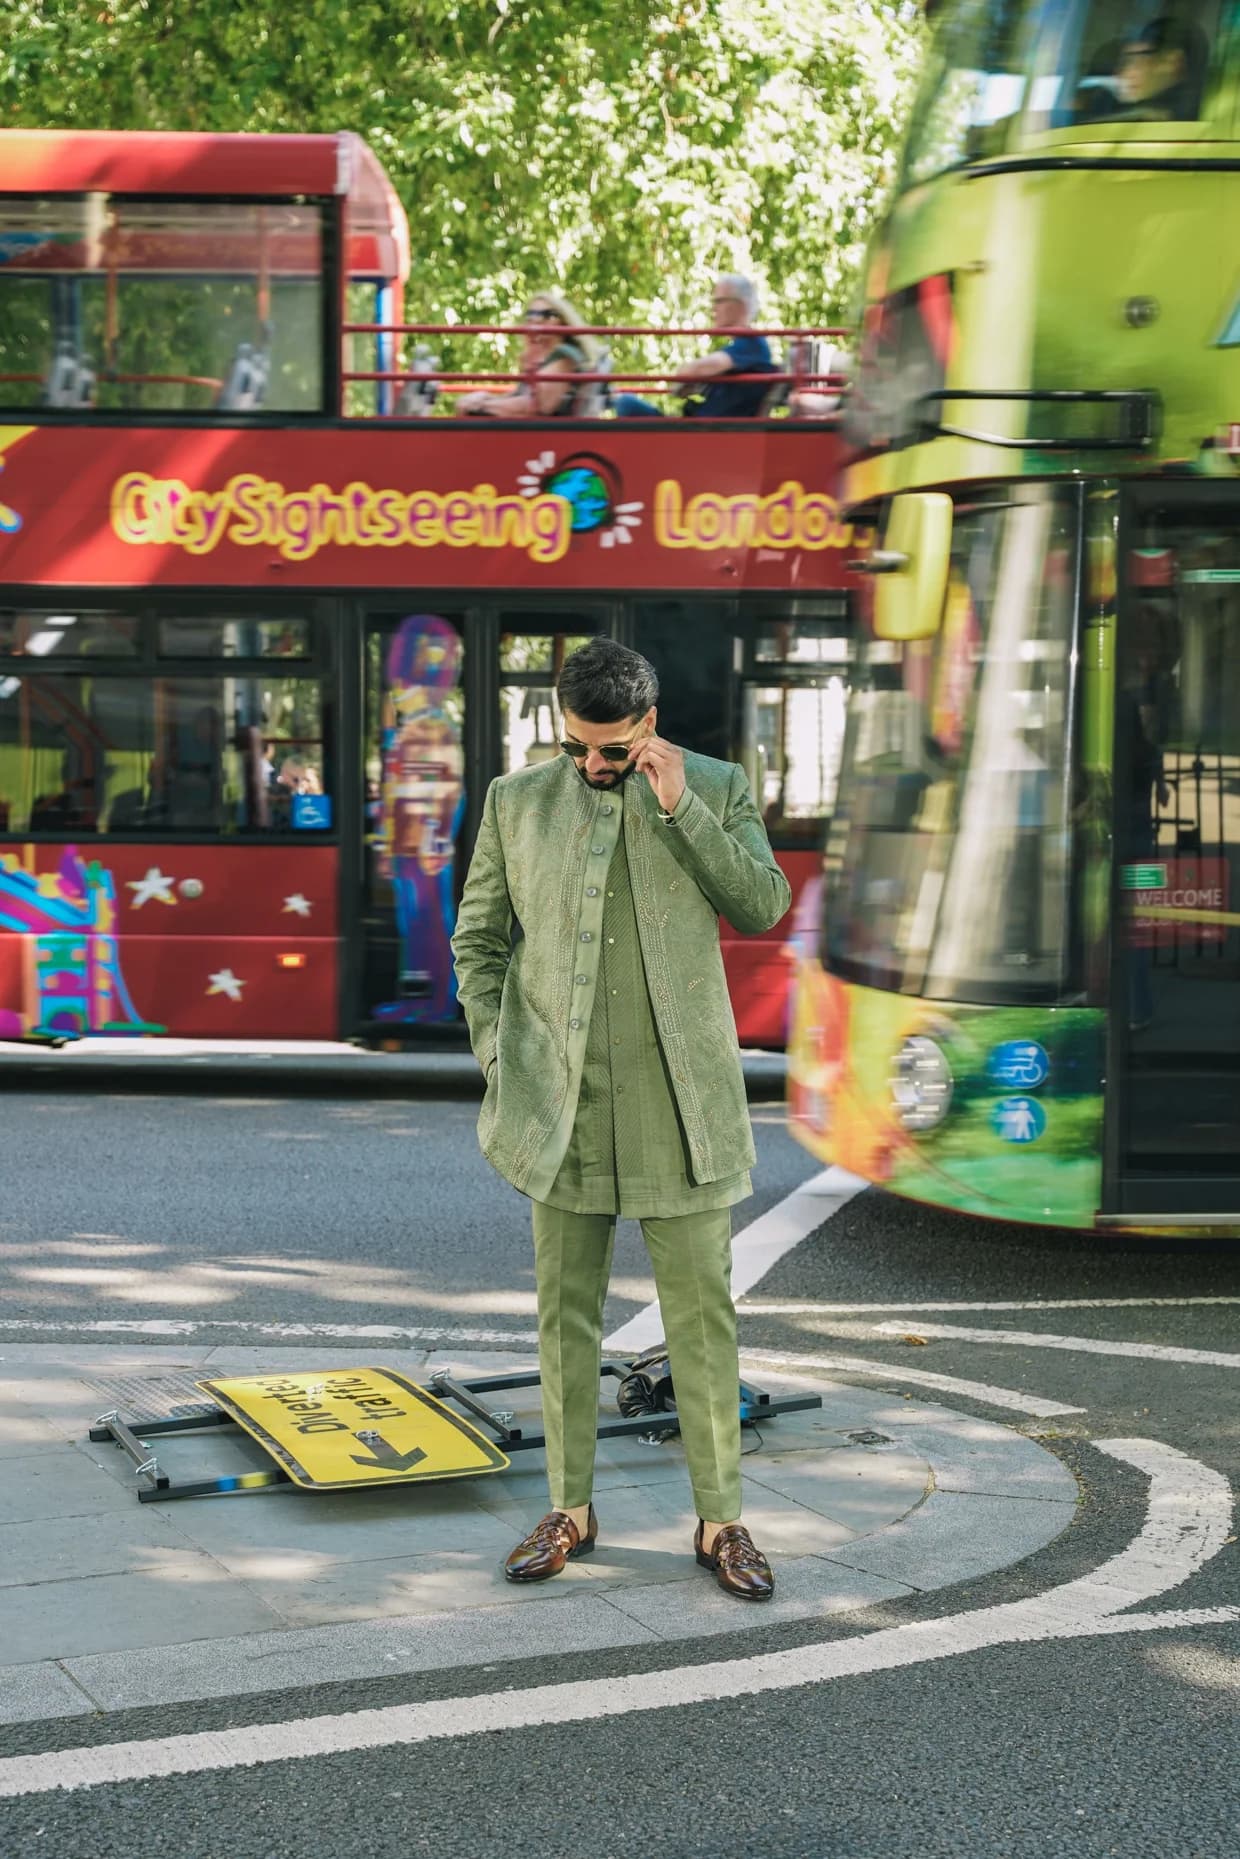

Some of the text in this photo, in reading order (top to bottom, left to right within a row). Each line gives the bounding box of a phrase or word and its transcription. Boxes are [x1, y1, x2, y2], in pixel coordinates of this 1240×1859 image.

[1135, 888, 1223, 907] WELCOME
[243, 1378, 350, 1434] Diverted
[325, 1377, 408, 1421] traffic
